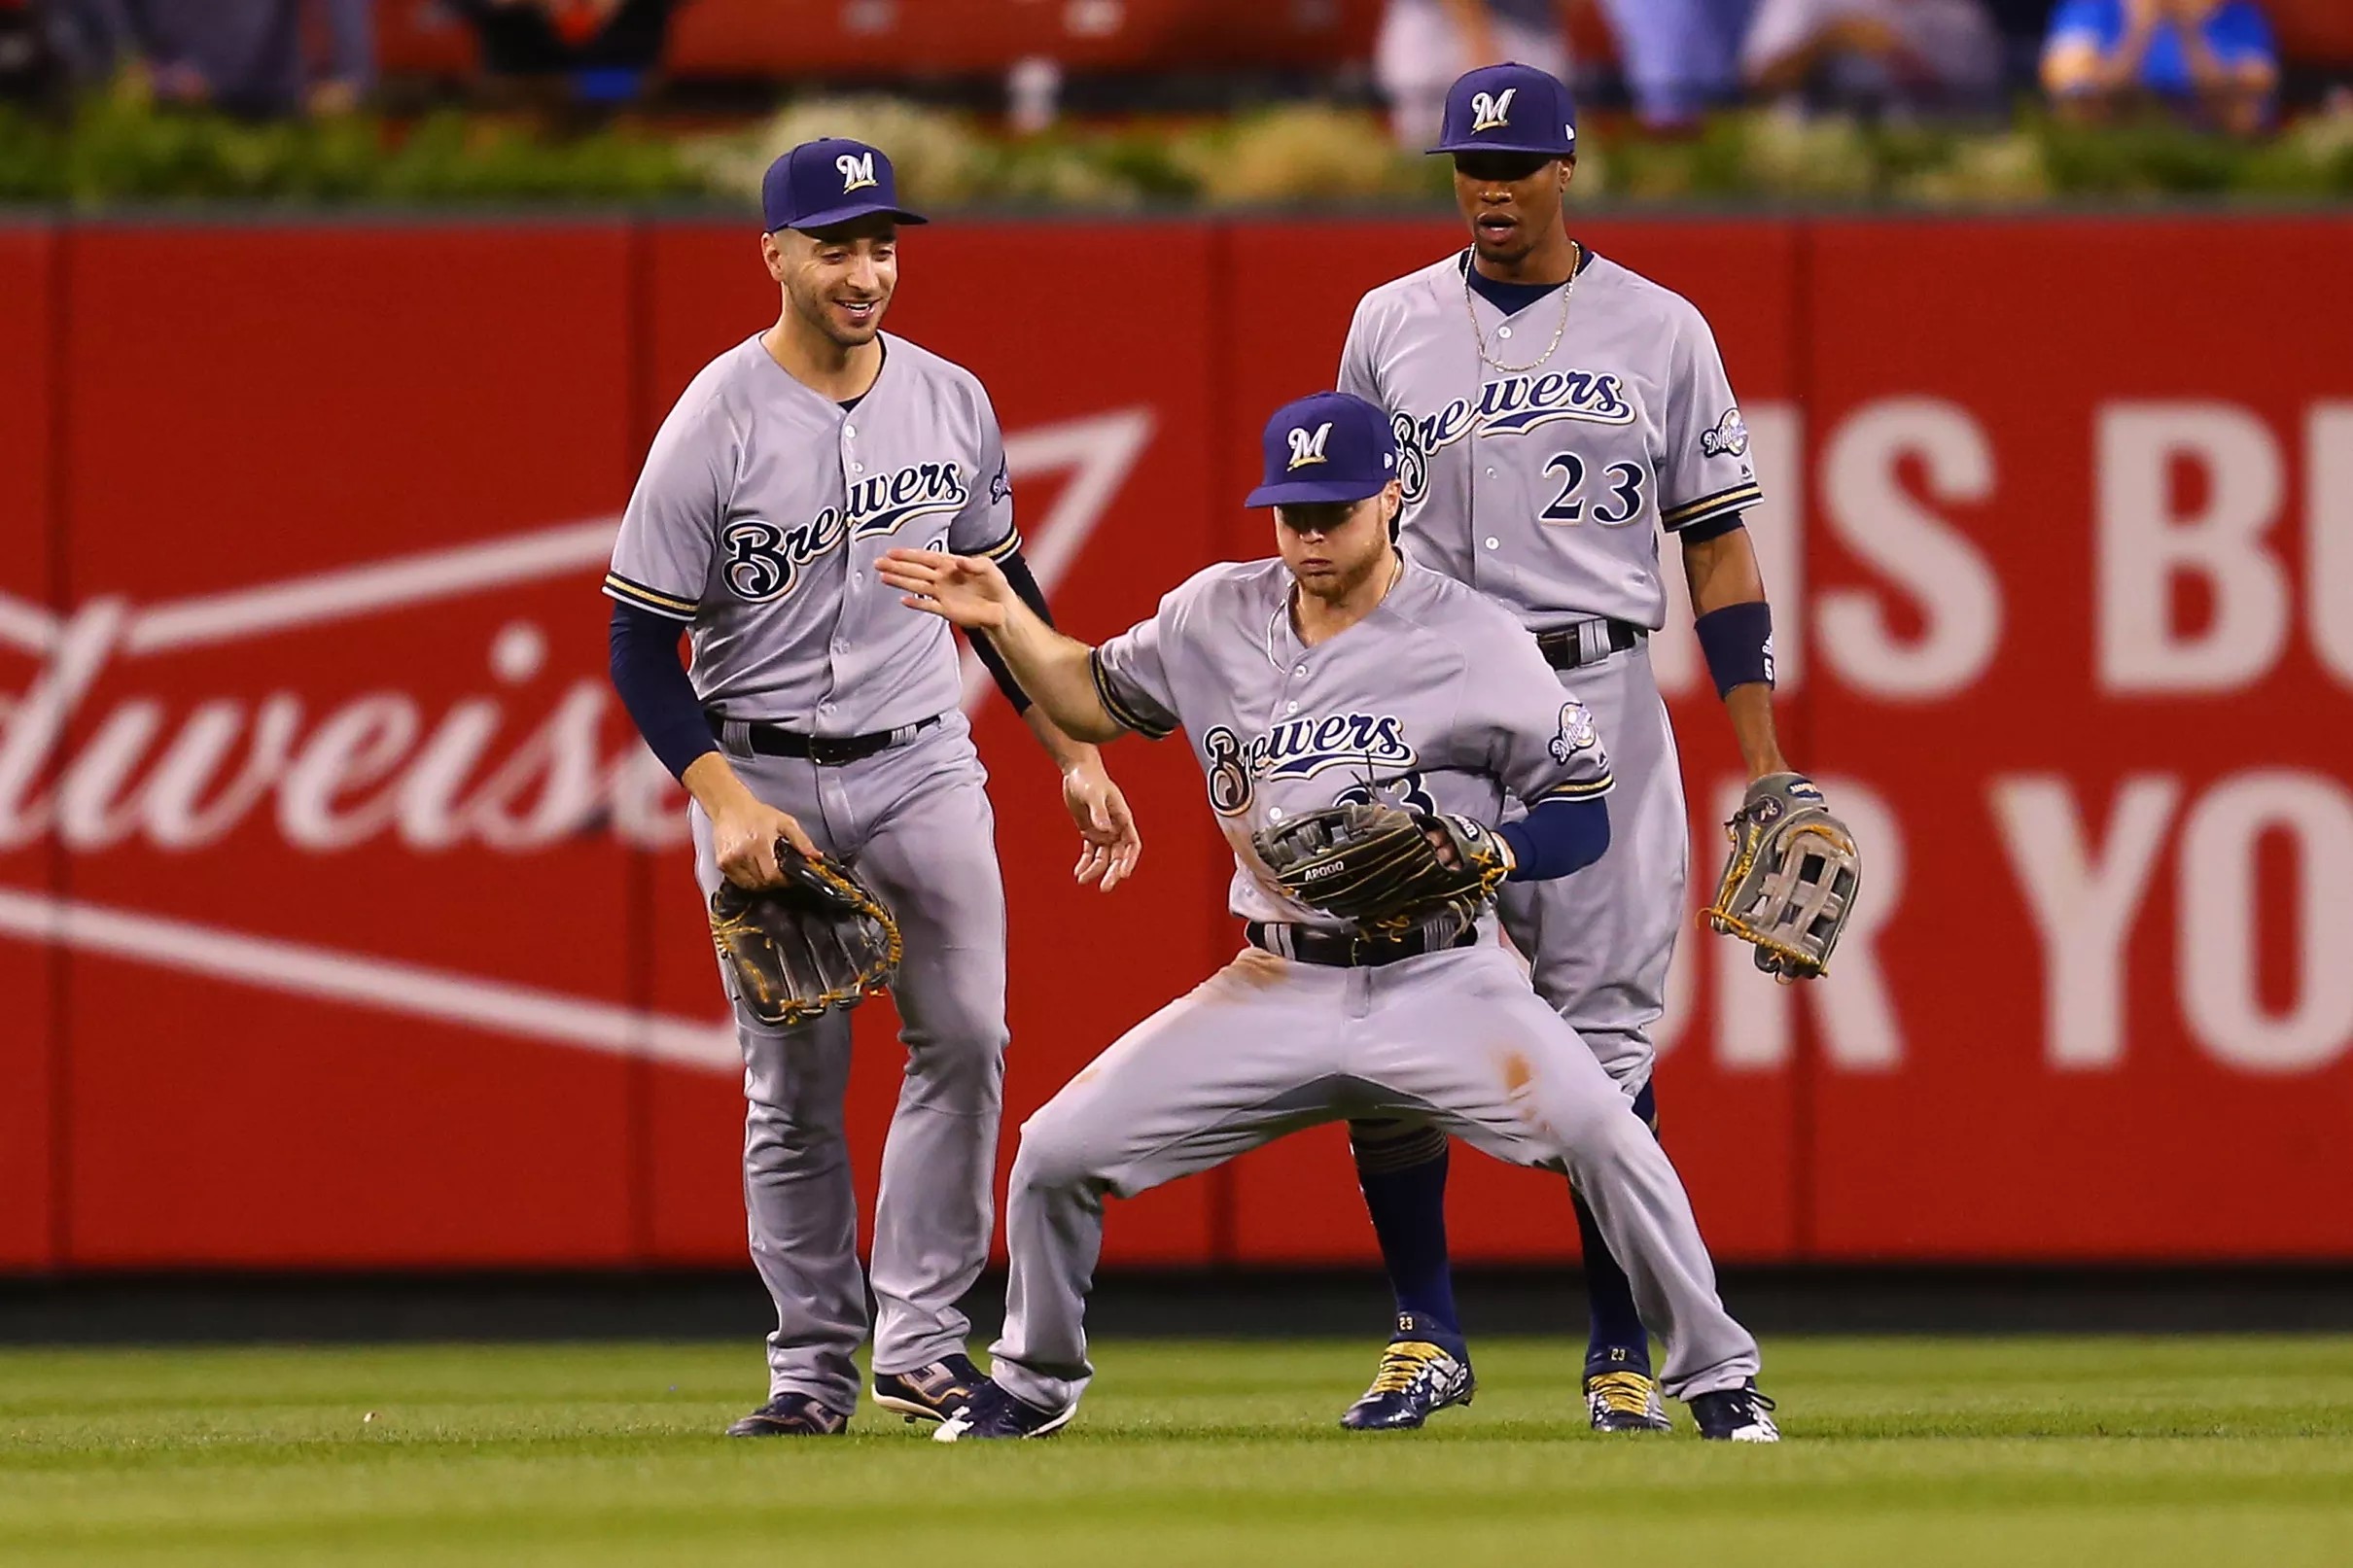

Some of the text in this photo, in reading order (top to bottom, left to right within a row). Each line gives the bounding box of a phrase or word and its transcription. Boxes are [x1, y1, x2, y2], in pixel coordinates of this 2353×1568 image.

[1470, 87, 1517, 135] M
[836, 152, 877, 194] M
[1286, 422, 1333, 471] M
[1391, 368, 1635, 504] Brewers
[1539, 452, 1647, 527] 23
[721, 460, 970, 604] Brewers
[1398, 1316, 1414, 1331] 23
[1611, 1347, 1627, 1361] 23
